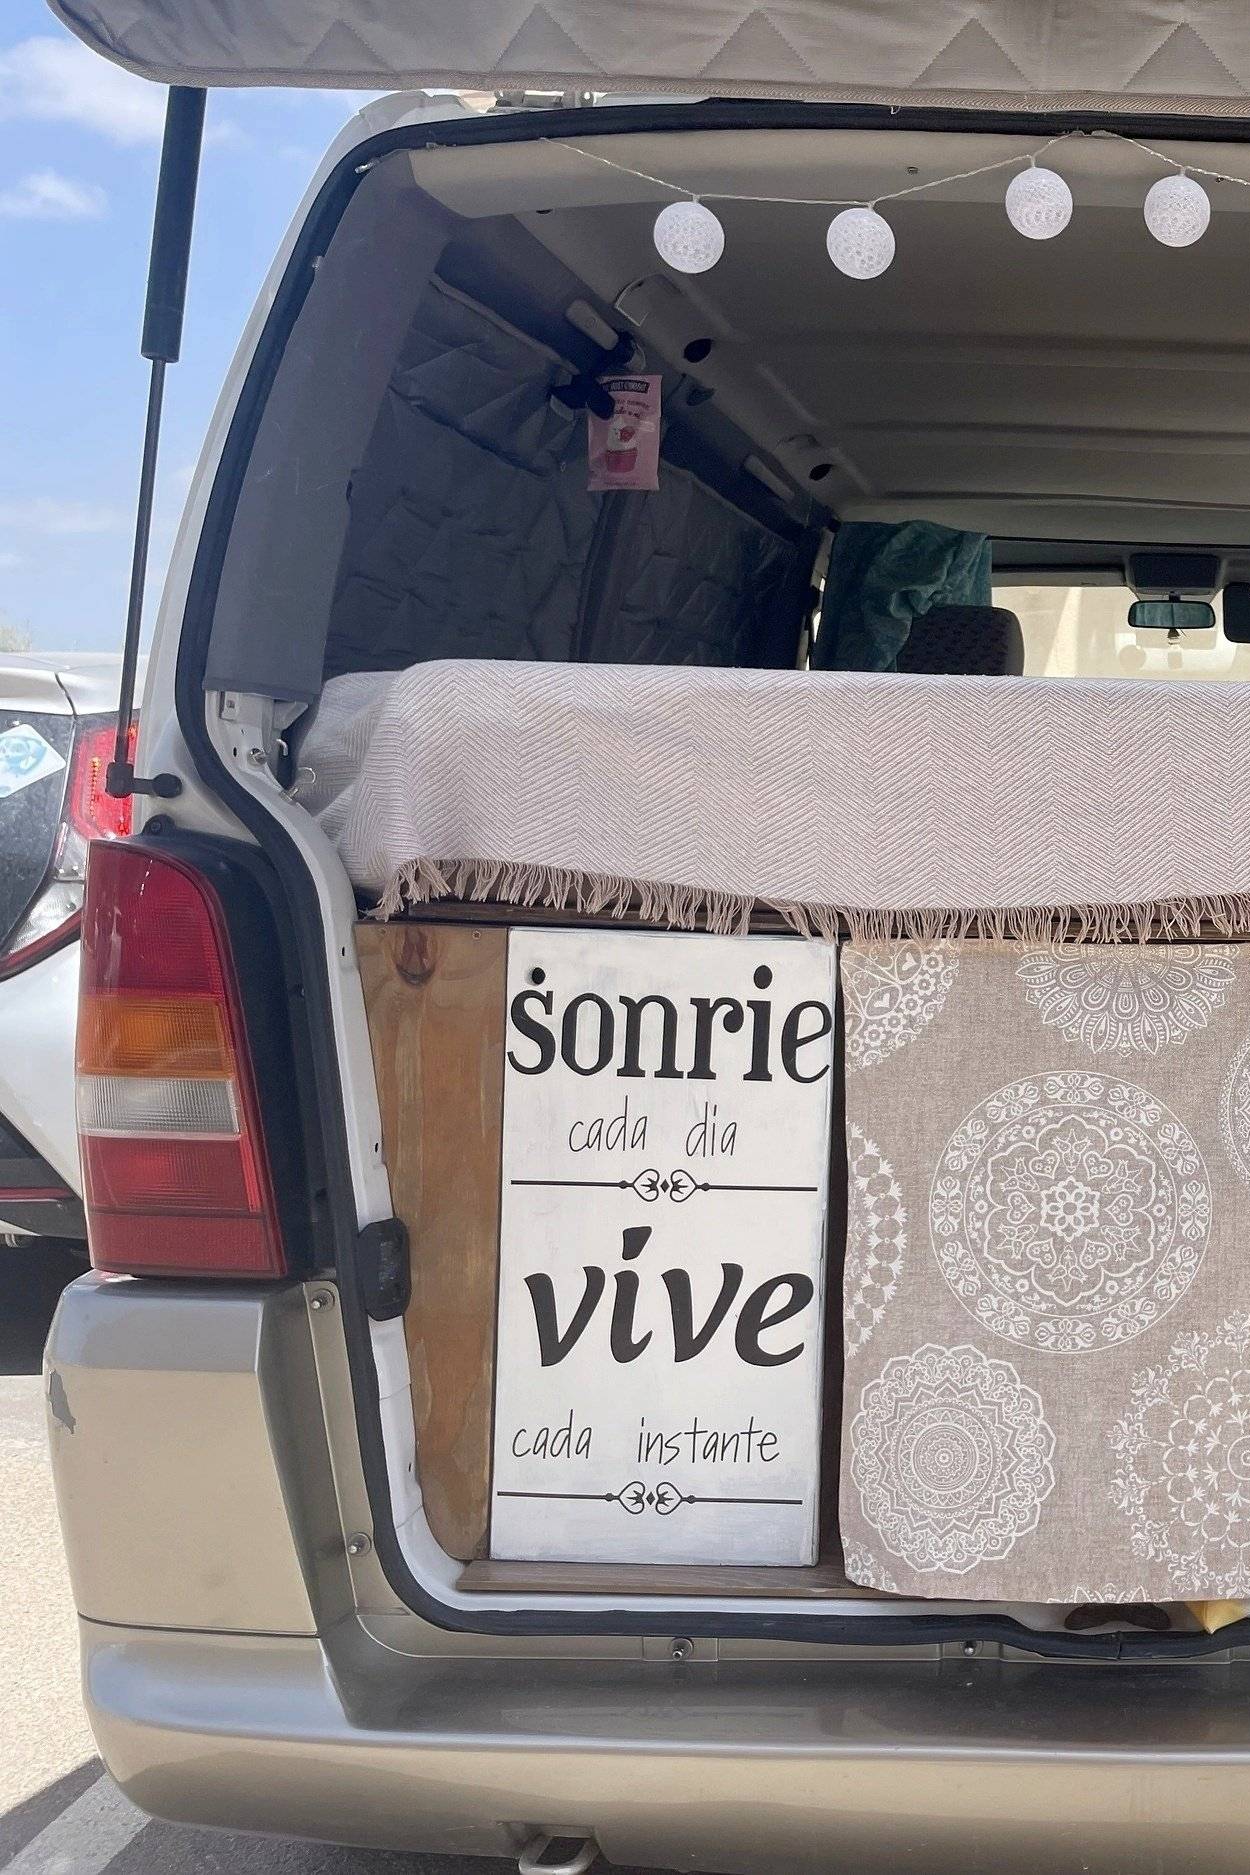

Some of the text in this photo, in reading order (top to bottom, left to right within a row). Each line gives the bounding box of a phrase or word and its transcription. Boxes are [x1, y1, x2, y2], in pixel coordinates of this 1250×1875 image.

[506, 964, 833, 1084] sonrie
[568, 1094, 738, 1158] cada dia
[523, 1225, 814, 1368] vive
[512, 1408, 780, 1466] cada instante
